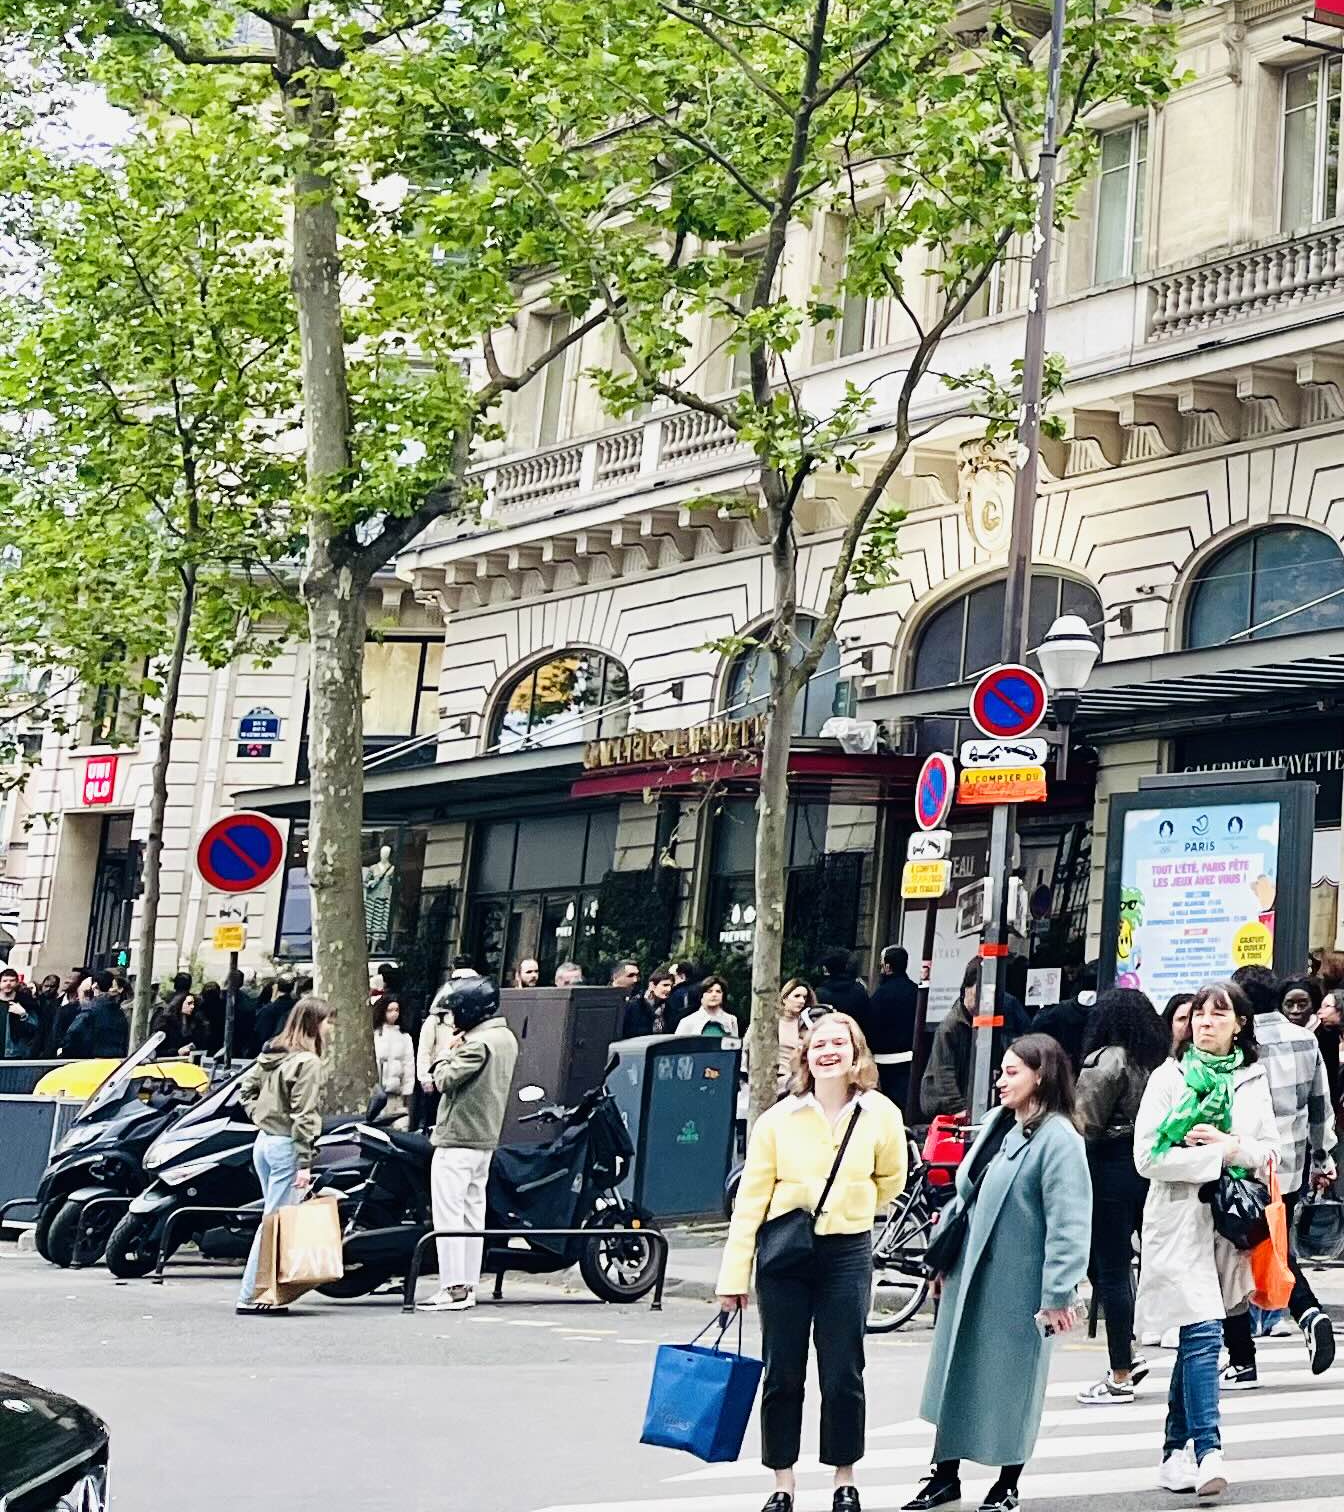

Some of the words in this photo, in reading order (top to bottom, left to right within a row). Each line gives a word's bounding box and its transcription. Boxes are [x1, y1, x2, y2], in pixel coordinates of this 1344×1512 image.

[86, 761, 112, 781] UNI
[975, 772, 1021, 784] COMPTER
[85, 780, 111, 801] QLO
[1184, 841, 1215, 852] PARIS
[1151, 864, 1172, 875] TOUT
[1202, 861, 1226, 873] PARIS
[1152, 877, 1168, 888] LES
[1171, 876, 1192, 887] JEUX
[1218, 873, 1240, 885] VOUS
